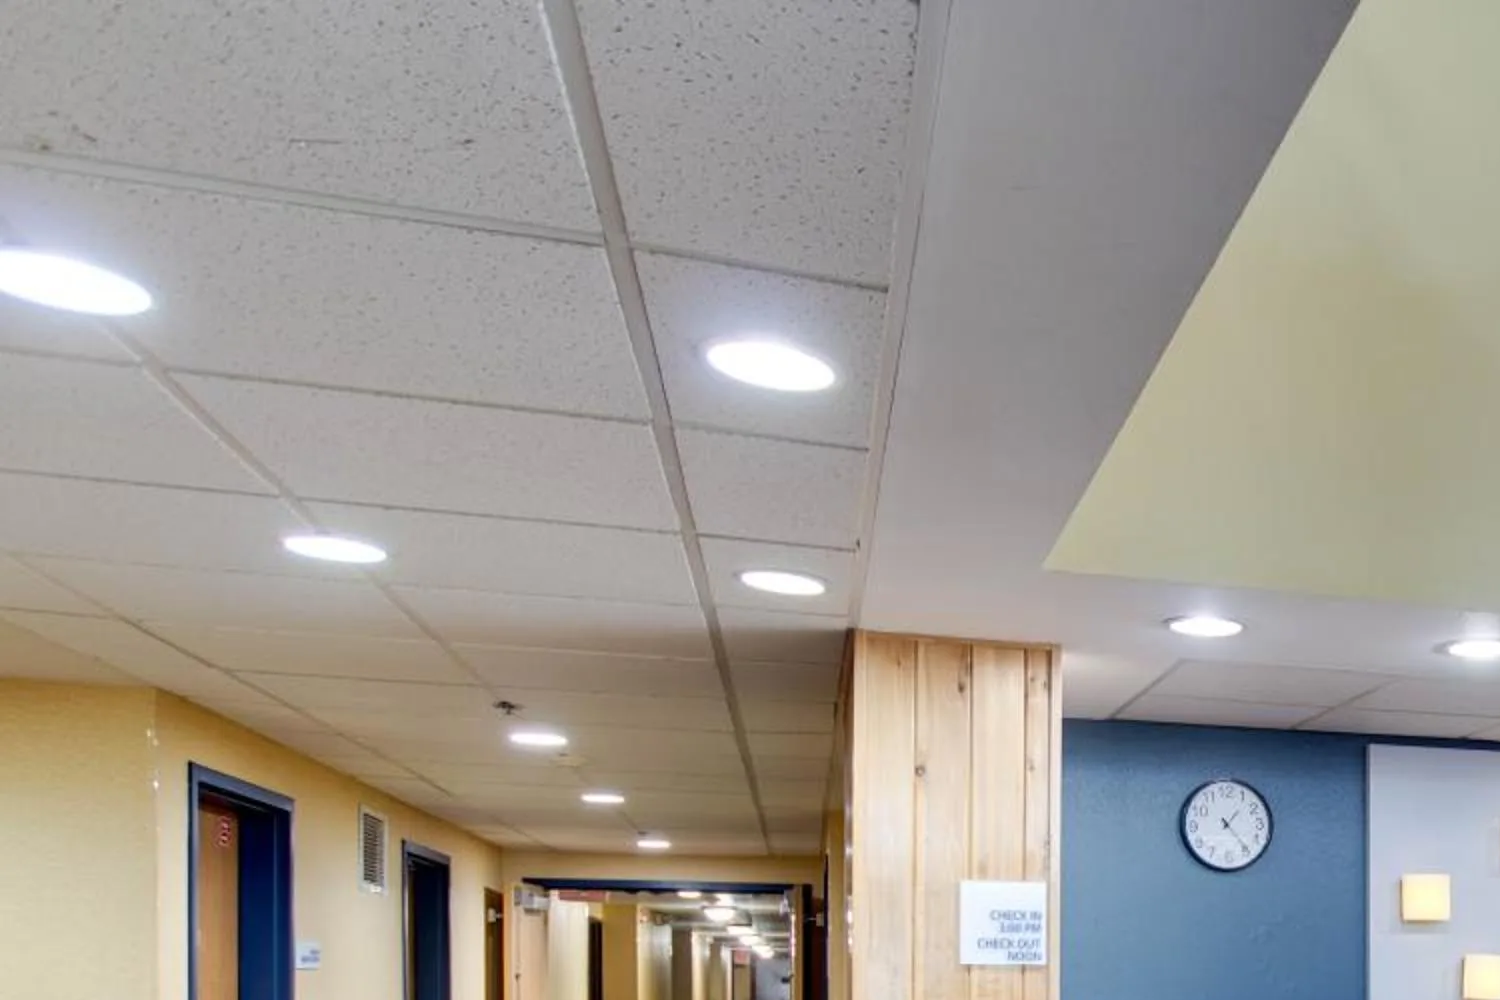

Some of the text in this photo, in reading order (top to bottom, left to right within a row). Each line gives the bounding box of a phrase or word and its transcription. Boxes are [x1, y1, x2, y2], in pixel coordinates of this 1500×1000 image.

[1203, 791, 1215, 803] 11
[1218, 784, 1234, 798] 12
[1192, 804, 1208, 817] 10
[1249, 802, 1259, 815] 2
[989, 909, 1043, 921] CHECK IN
[977, 937, 1041, 949] CHECK OUT
[1007, 950, 1043, 962] NOON
